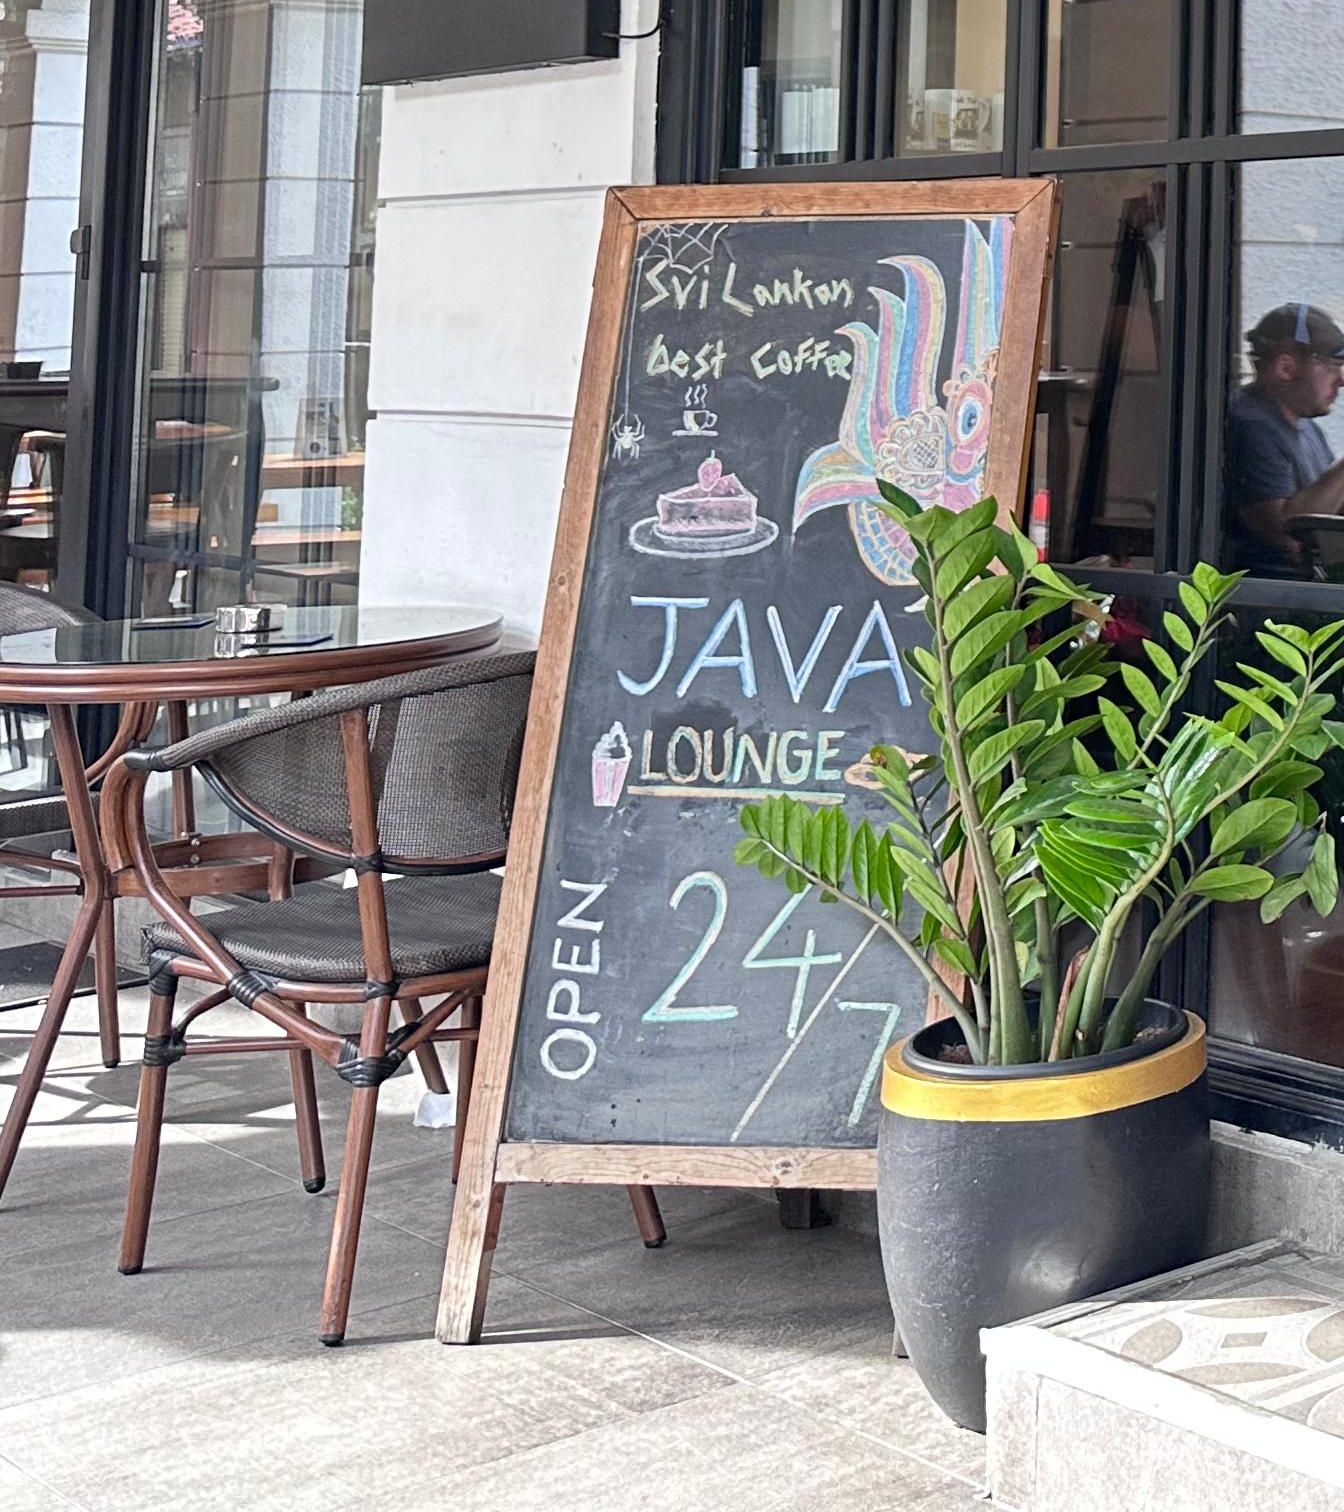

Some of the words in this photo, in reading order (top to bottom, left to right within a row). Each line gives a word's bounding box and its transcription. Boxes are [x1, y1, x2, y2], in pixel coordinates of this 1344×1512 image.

[721, 260, 855, 316] Lankan
[616, 594, 913, 714] JAVA
[639, 726, 846, 786] LOUNGE
[540, 878, 608, 1081] OPEN
